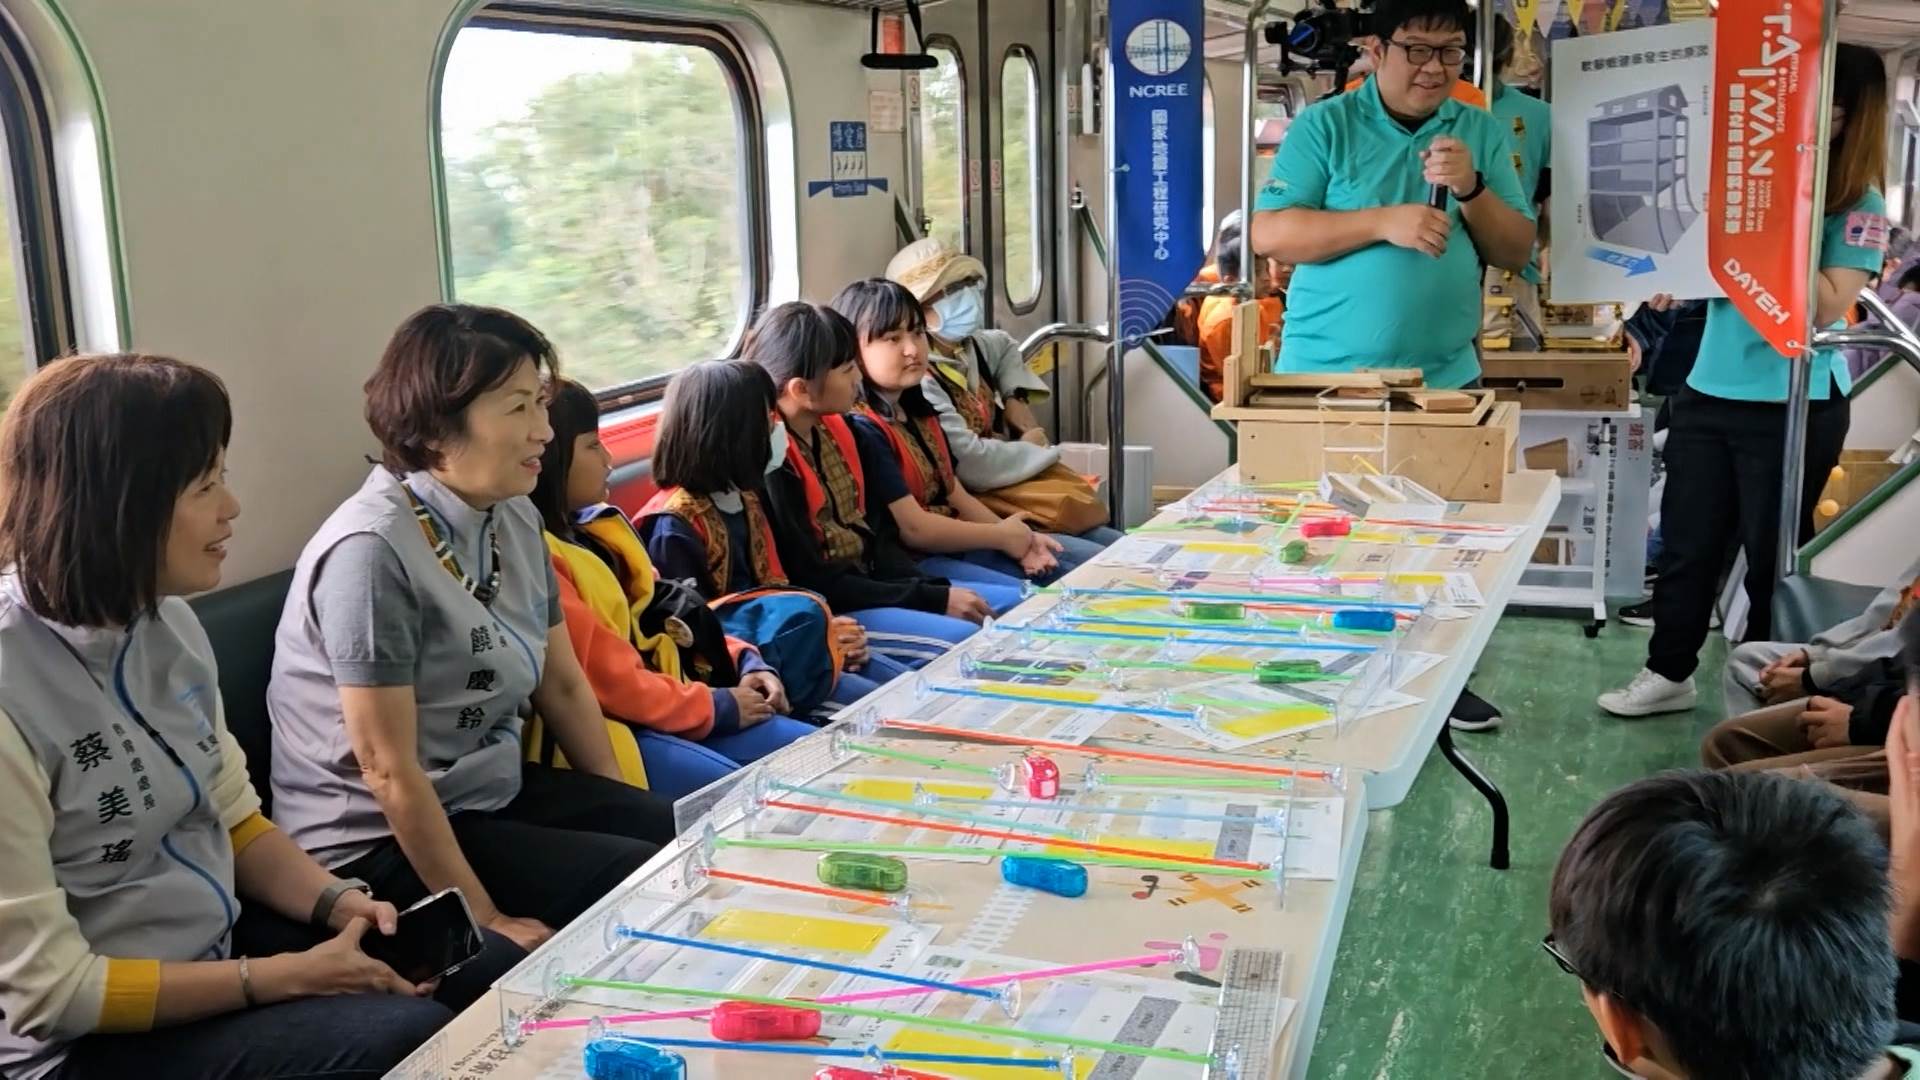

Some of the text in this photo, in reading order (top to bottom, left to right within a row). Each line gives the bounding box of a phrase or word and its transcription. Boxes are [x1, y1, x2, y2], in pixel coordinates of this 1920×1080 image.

[1129, 83, 1189, 98] NCREE
[1151, 109, 1169, 260] 國家地震工程研究中心
[1723, 258, 1790, 325] DAYEH
[456, 625, 496, 730] 饒慶鈴
[69, 731, 133, 864] 蔡美瑤
